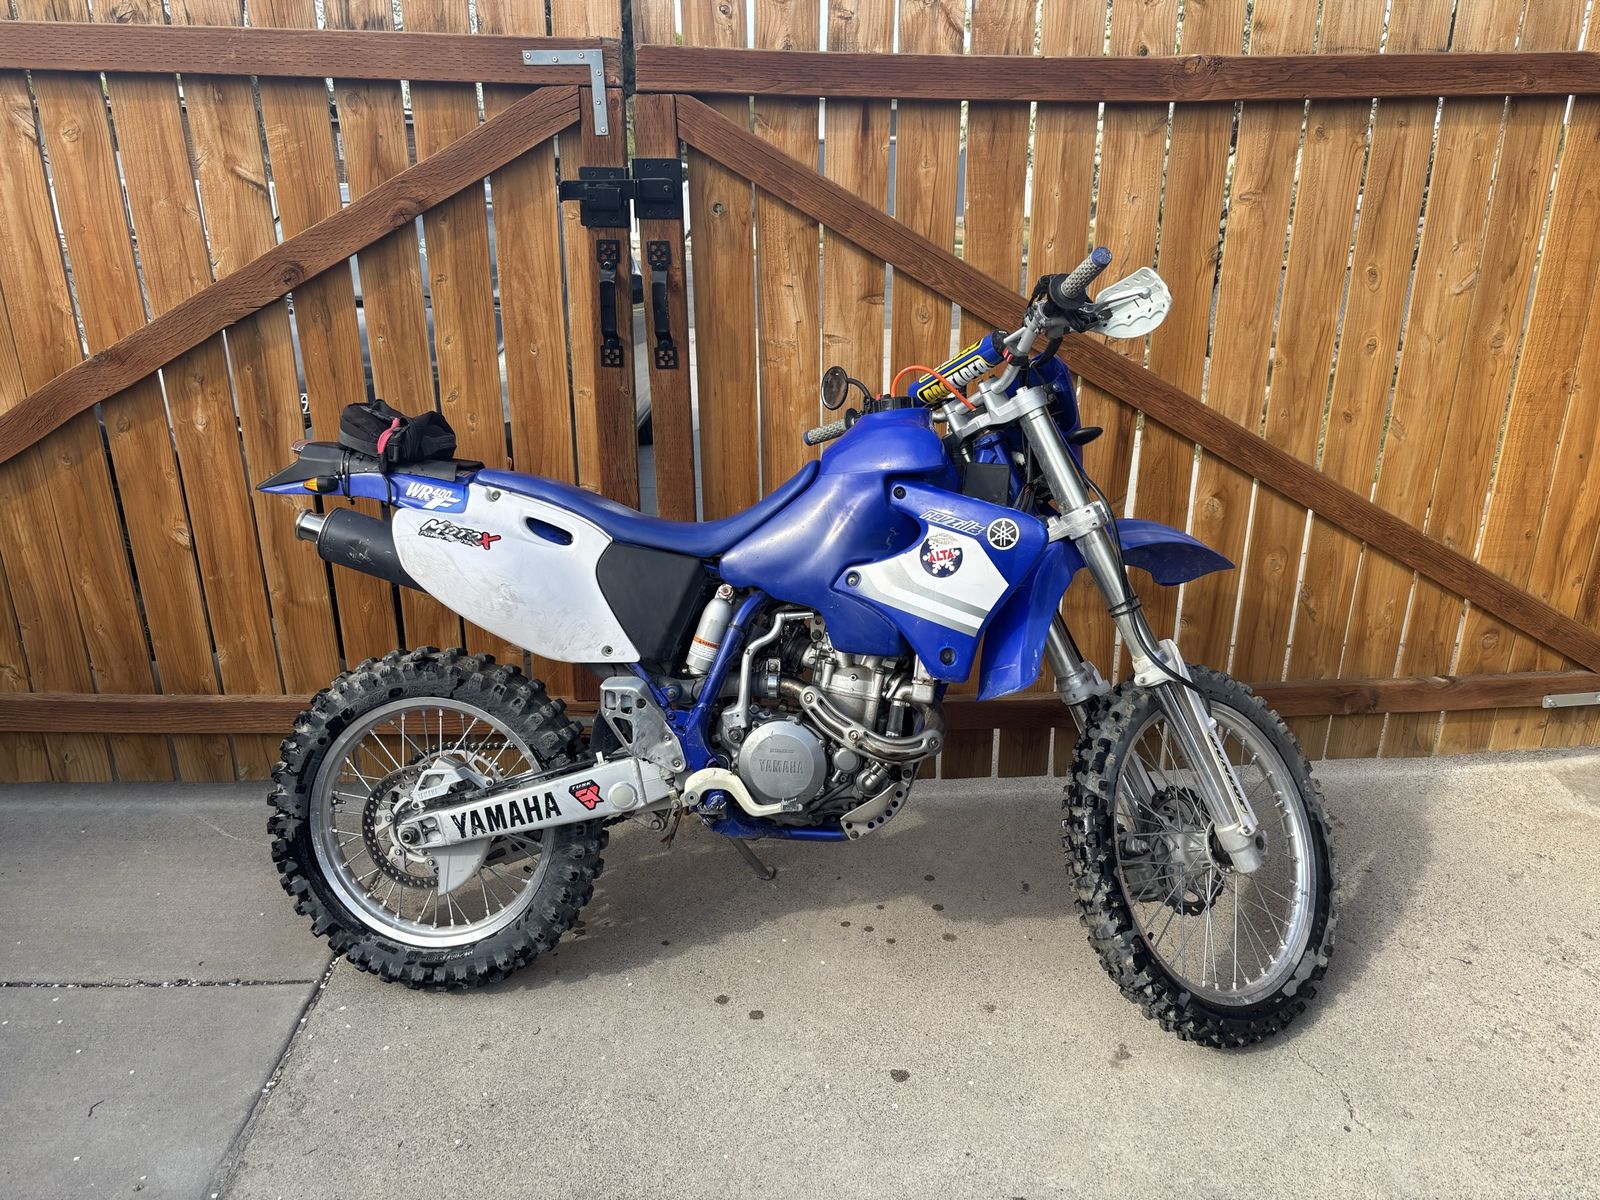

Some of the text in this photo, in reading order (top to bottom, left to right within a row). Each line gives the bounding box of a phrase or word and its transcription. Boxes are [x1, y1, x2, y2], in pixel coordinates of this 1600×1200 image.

[928, 549, 955, 563] ALTA
[758, 759, 804, 775] YAMAHA
[451, 792, 562, 838] YAMAHA
